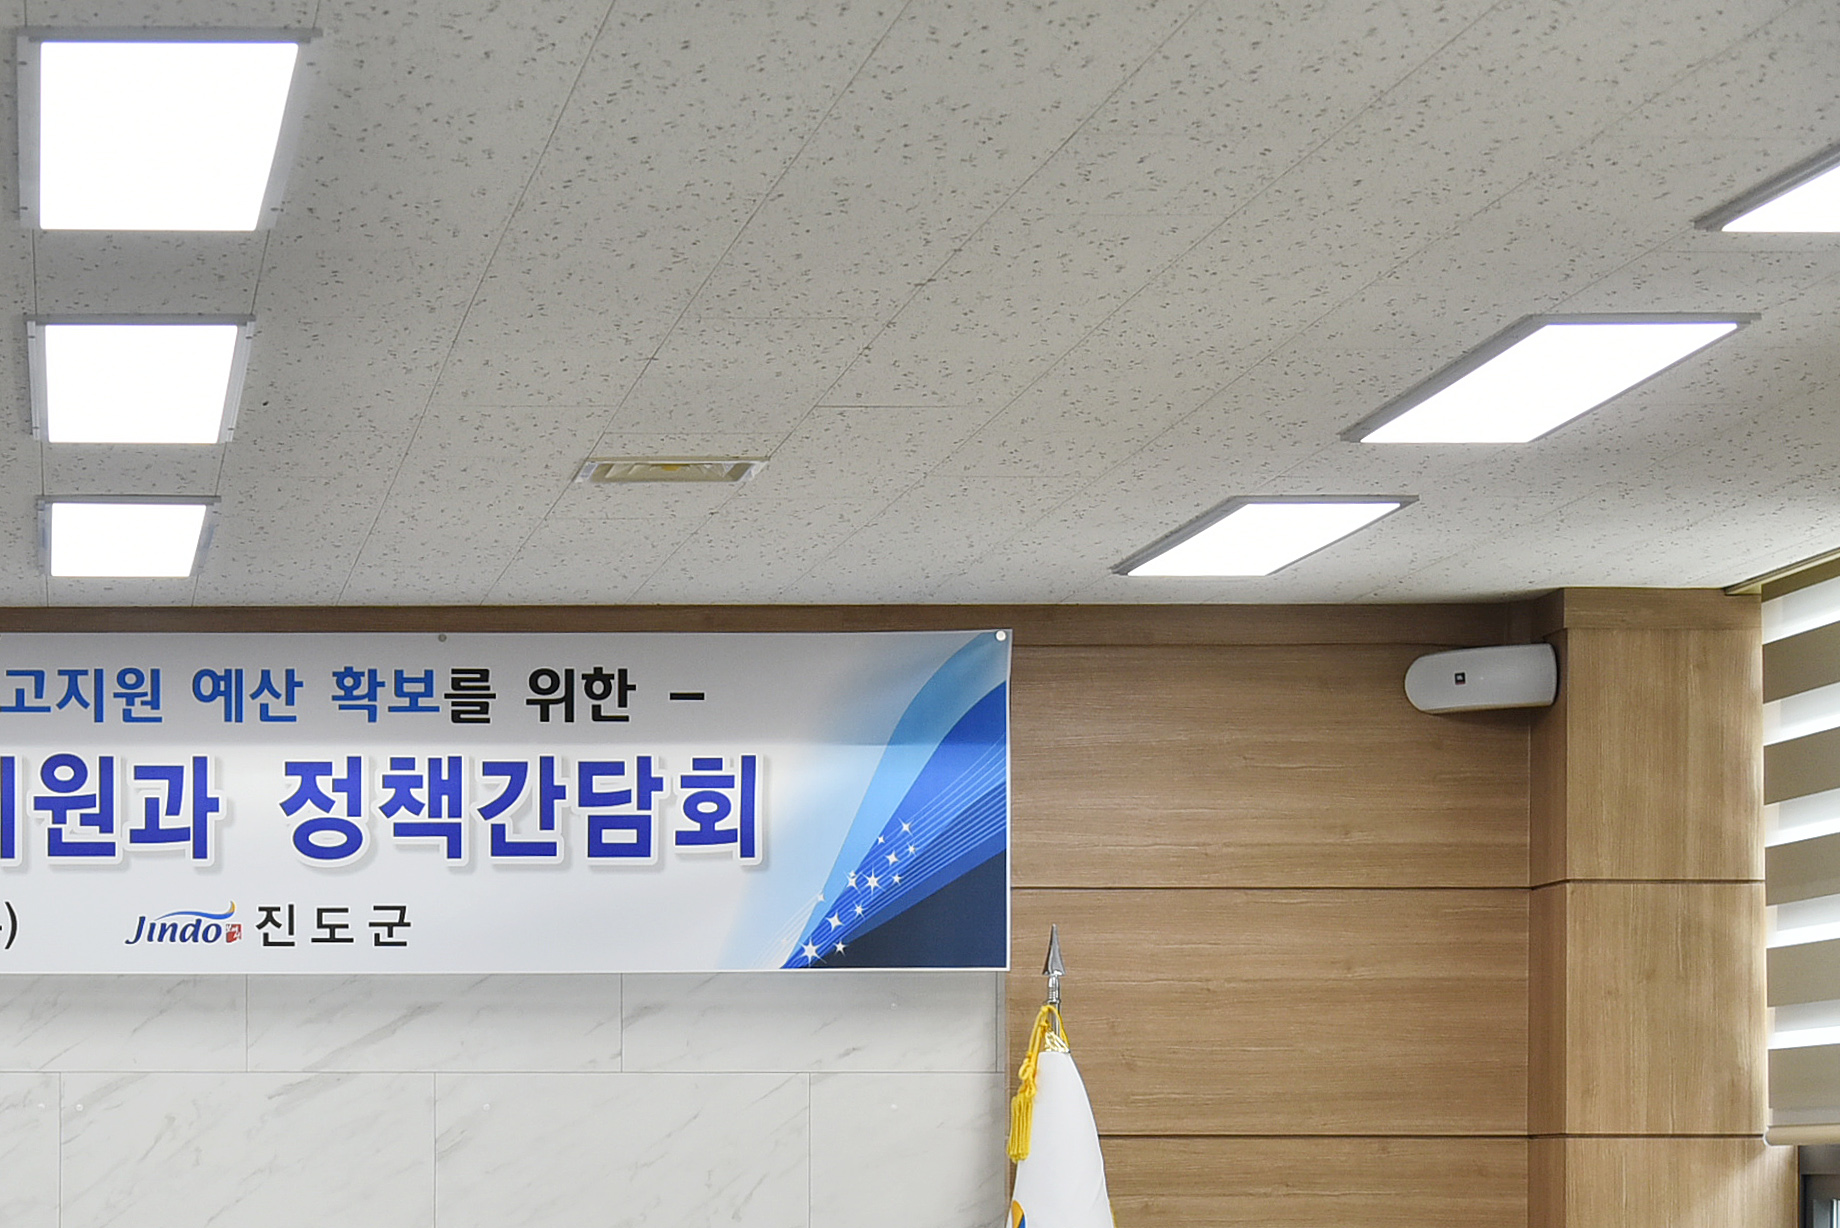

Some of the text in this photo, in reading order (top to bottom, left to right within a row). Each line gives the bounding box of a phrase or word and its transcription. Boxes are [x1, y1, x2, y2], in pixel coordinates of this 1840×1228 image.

[192, 666, 304, 724] 예산
[331, 665, 497, 724] 확보를
[525, 666, 637, 724] 위한
[278, 753, 758, 861] 정책간담회
[124, 915, 223, 945] Jindo
[255, 903, 412, 947] 진도군
